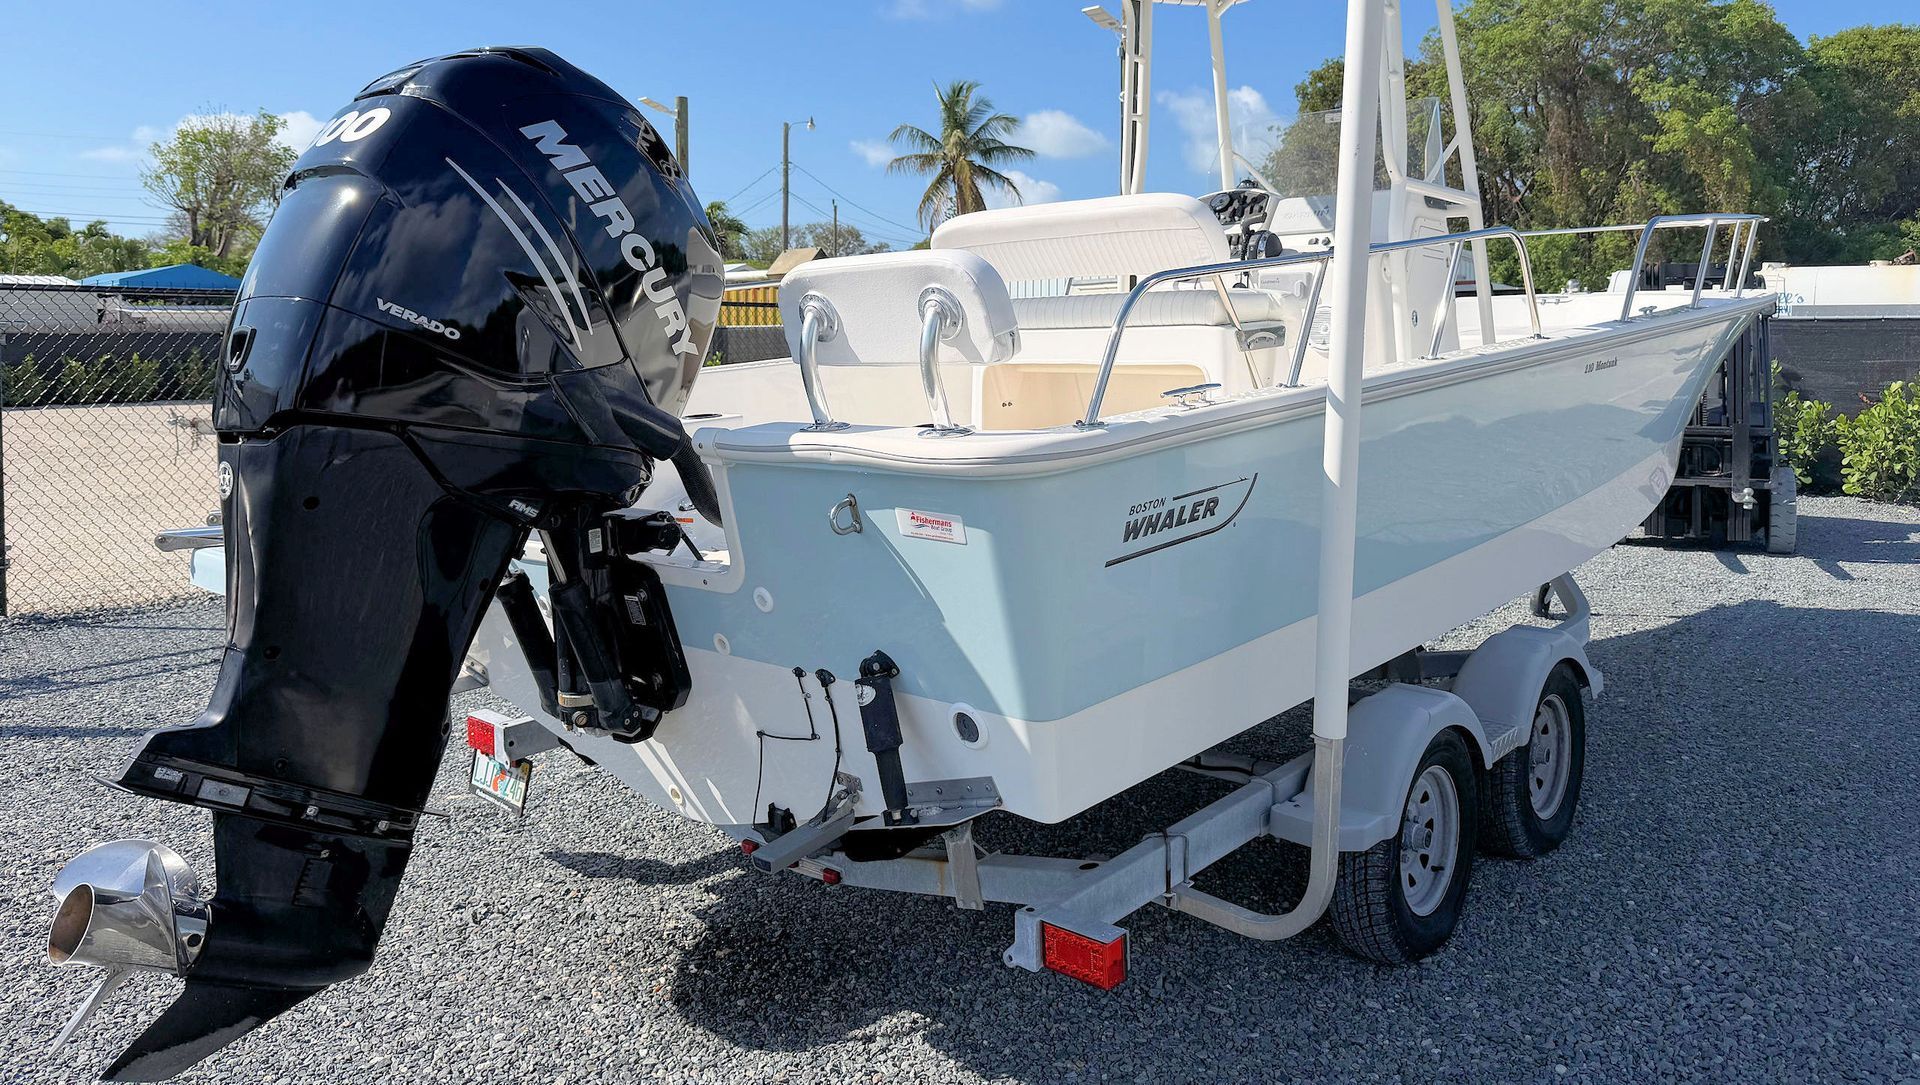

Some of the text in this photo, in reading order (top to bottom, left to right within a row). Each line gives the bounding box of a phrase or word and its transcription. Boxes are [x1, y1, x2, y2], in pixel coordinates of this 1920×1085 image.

[308, 108, 391, 149] 00
[519, 119, 699, 357] MERCURY
[376, 297, 461, 340] VERADO
[1122, 496, 1219, 544] BOSTON WHALER
